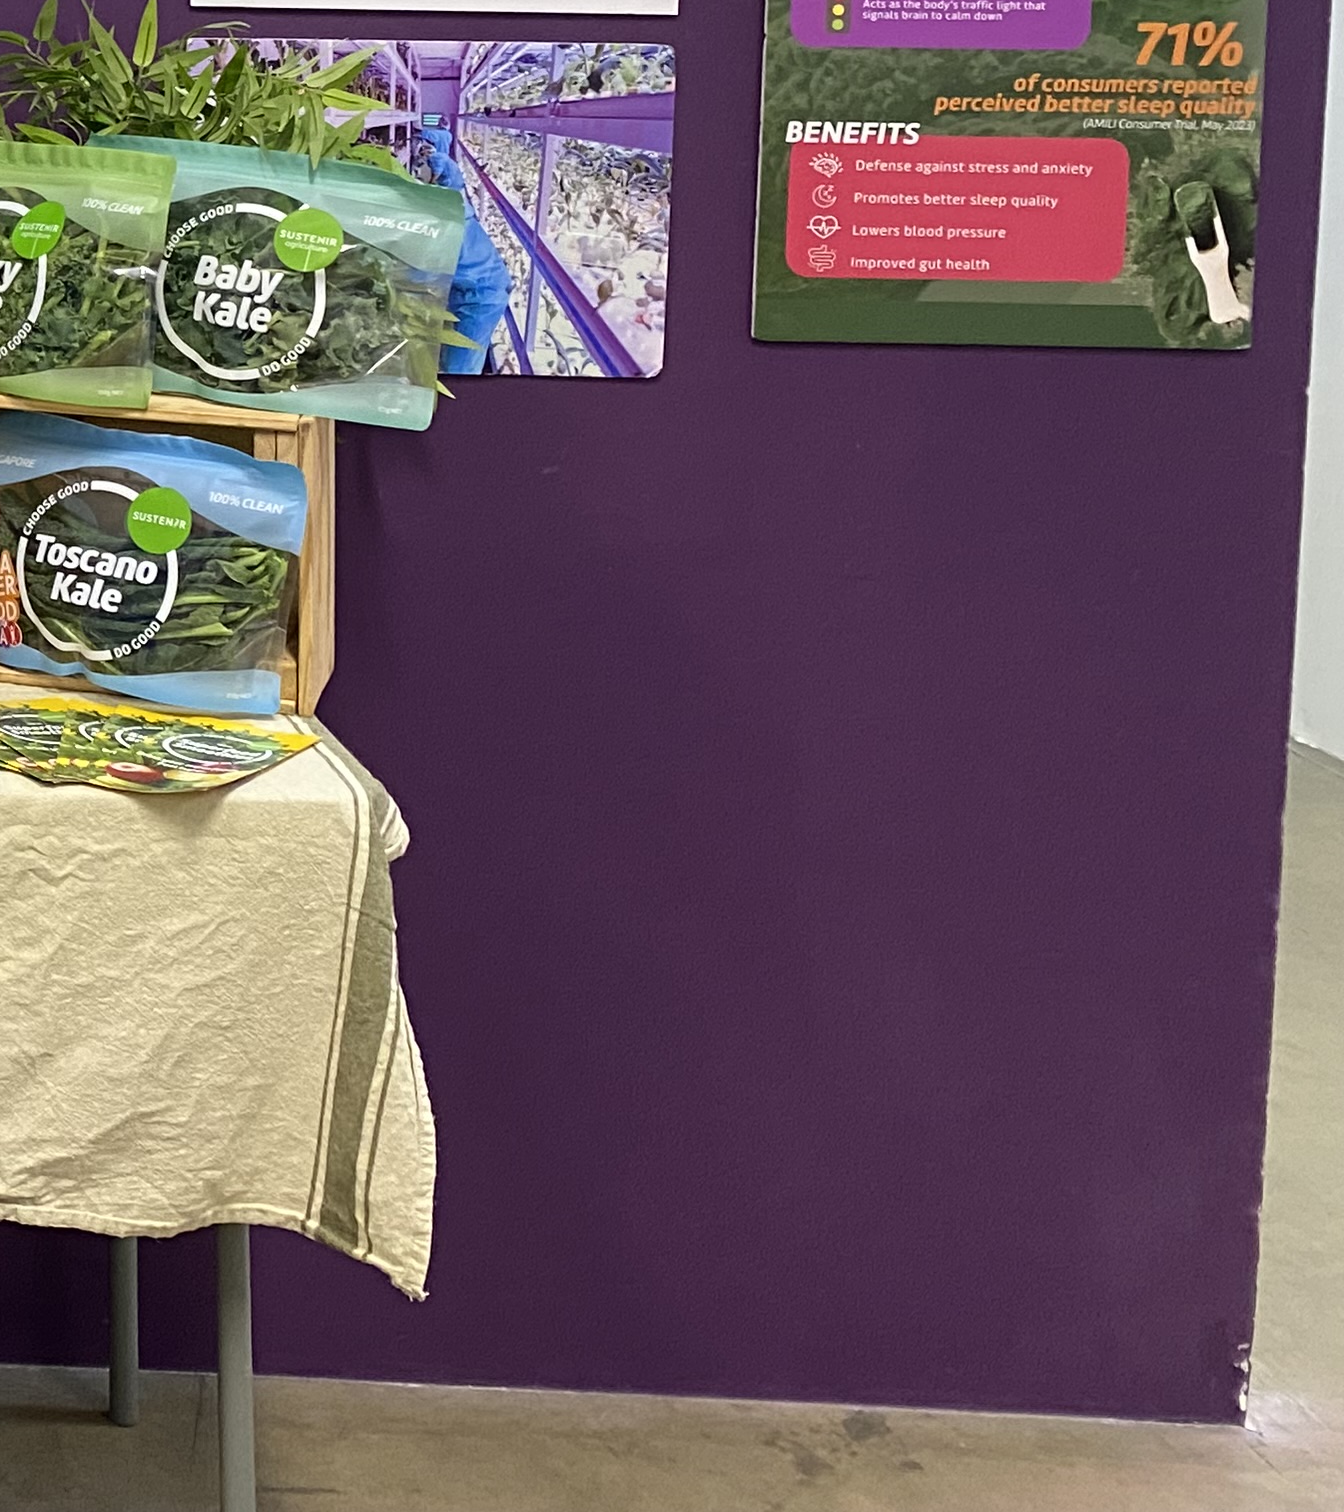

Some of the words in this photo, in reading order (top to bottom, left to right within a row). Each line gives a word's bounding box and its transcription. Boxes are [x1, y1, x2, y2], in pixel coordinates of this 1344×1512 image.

[1134, 21, 1245, 69] 71%
[1014, 73, 1042, 94] of
[1042, 76, 1160, 95] consumers
[1161, 75, 1260, 97] reported
[934, 93, 1042, 116] perceived
[1043, 94, 1114, 115] better
[1117, 95, 1177, 118] sleep
[1178, 96, 1257, 120] quality
[784, 119, 921, 146] BENEFITS
[855, 159, 913, 175] Defense
[915, 160, 965, 178] against
[967, 161, 1011, 176] stress
[1012, 161, 1038, 177] and
[1040, 162, 1094, 180] anxiety
[853, 191, 921, 209] Promotes
[922, 192, 968, 208] better
[968, 192, 1009, 210] sleep
[1011, 194, 1059, 211] quality
[279, 229, 338, 248] SUSTENIR
[851, 224, 902, 240] Lowers
[904, 226, 944, 241] blood
[946, 228, 1007, 244] pressure
[850, 255, 917, 274] Improved
[919, 257, 942, 274] gut
[944, 257, 991, 272] health
[193, 254, 285, 304] Baby
[192, 290, 273, 333] Kale
[22, 493, 57, 537] CHOOSE
[55, 481, 90, 501] GOOD
[208, 491, 241, 507] 100%
[241, 497, 285, 515] CLEAN
[131, 511, 187, 531] SUSTENIR
[34, 533, 159, 586] Toscano
[50, 572, 123, 614] Kale
